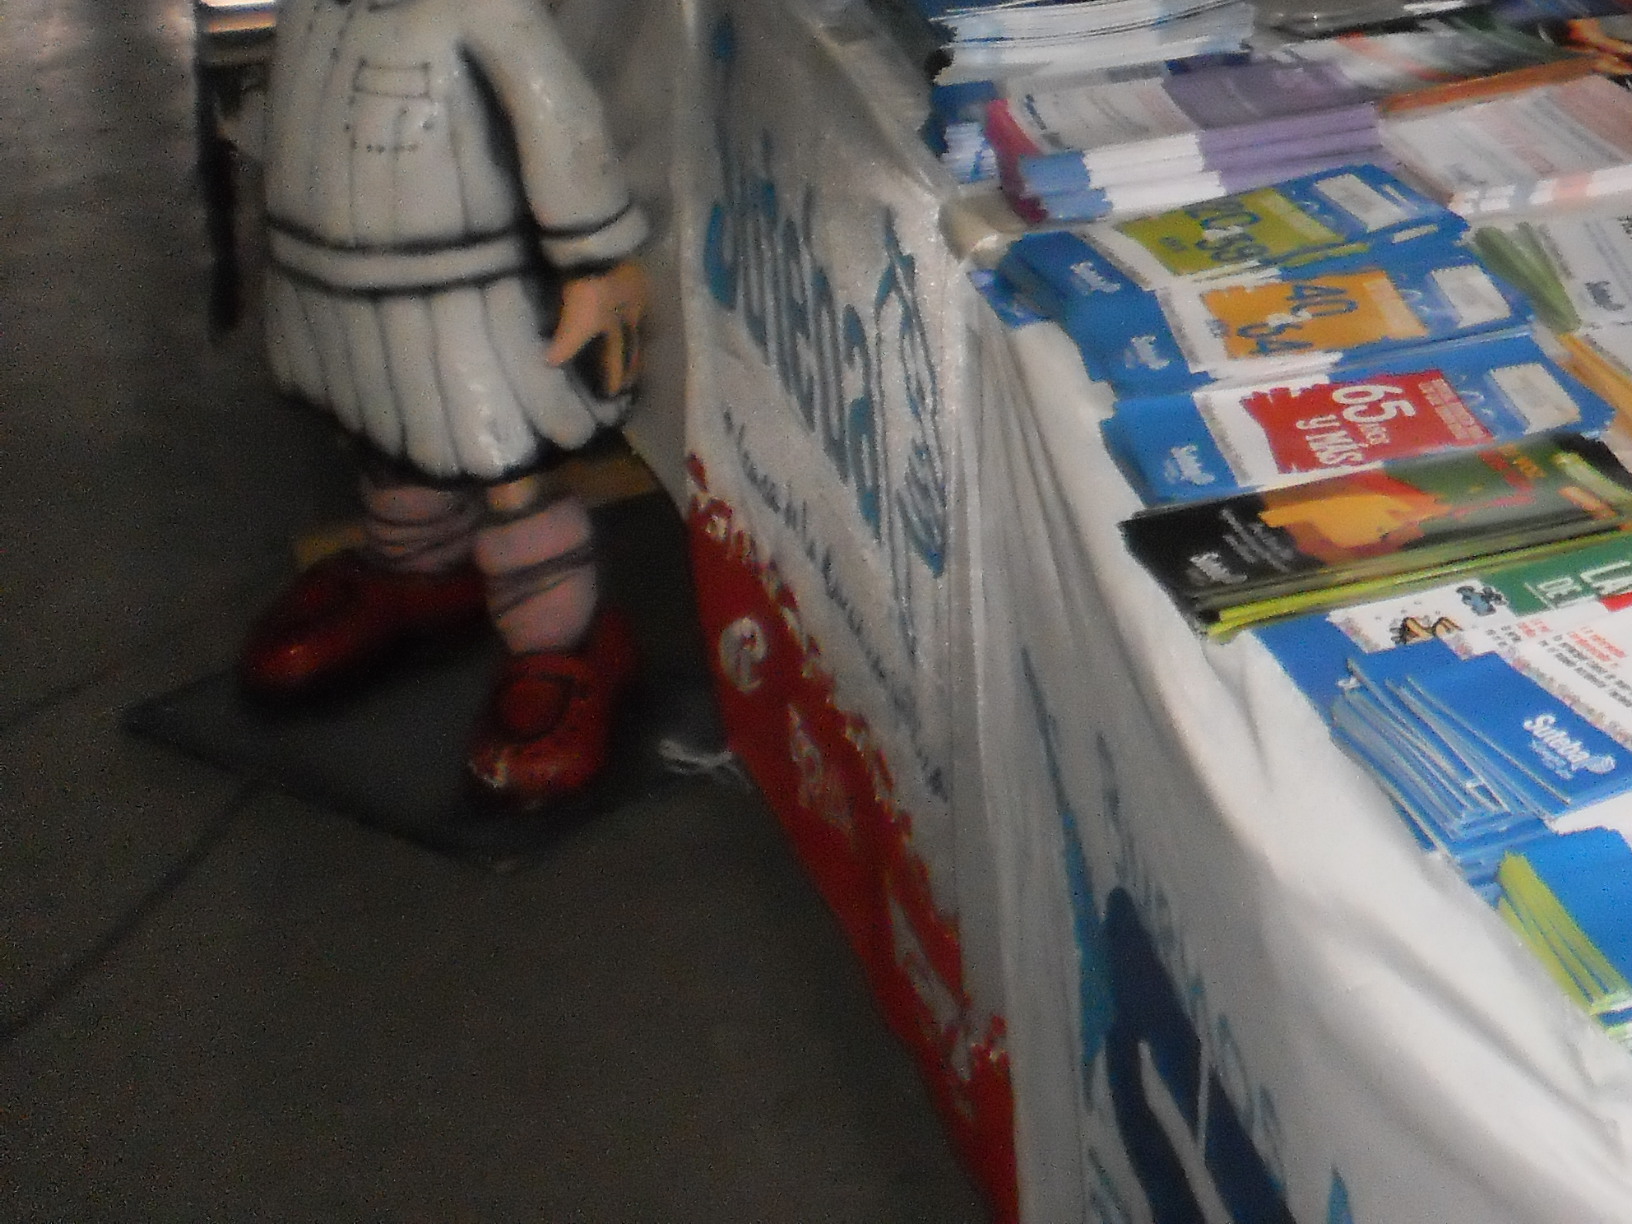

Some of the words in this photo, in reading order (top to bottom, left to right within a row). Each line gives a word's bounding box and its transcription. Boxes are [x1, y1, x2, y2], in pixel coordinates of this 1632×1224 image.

[1286, 285, 1358, 317] 40
[1237, 323, 1313, 356] 64
[1332, 385, 1416, 424] 65
